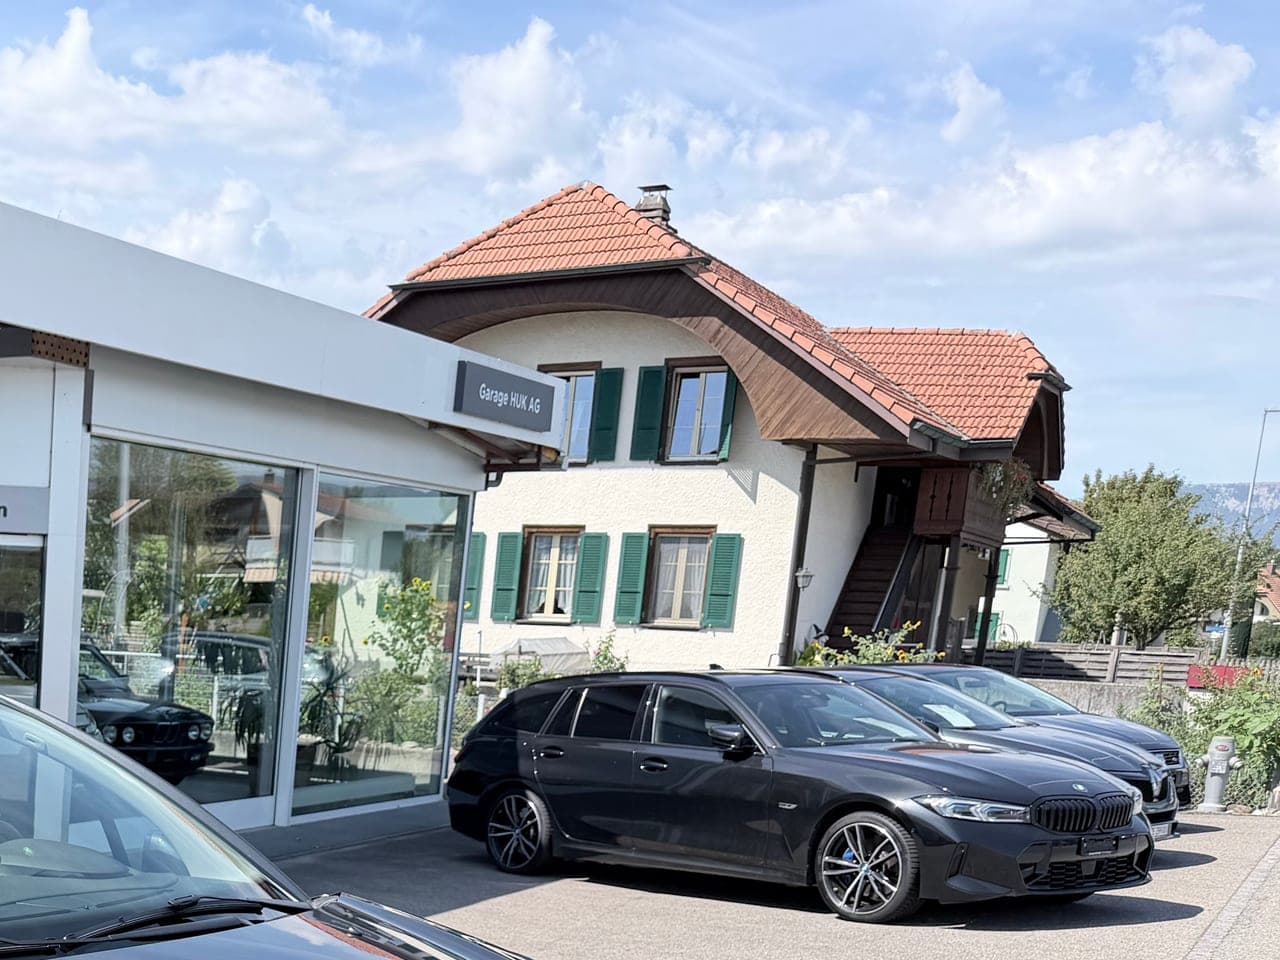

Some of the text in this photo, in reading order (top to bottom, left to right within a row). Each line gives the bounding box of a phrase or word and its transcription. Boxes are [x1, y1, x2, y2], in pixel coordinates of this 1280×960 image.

[479, 383, 541, 414] Garage HUK AG
